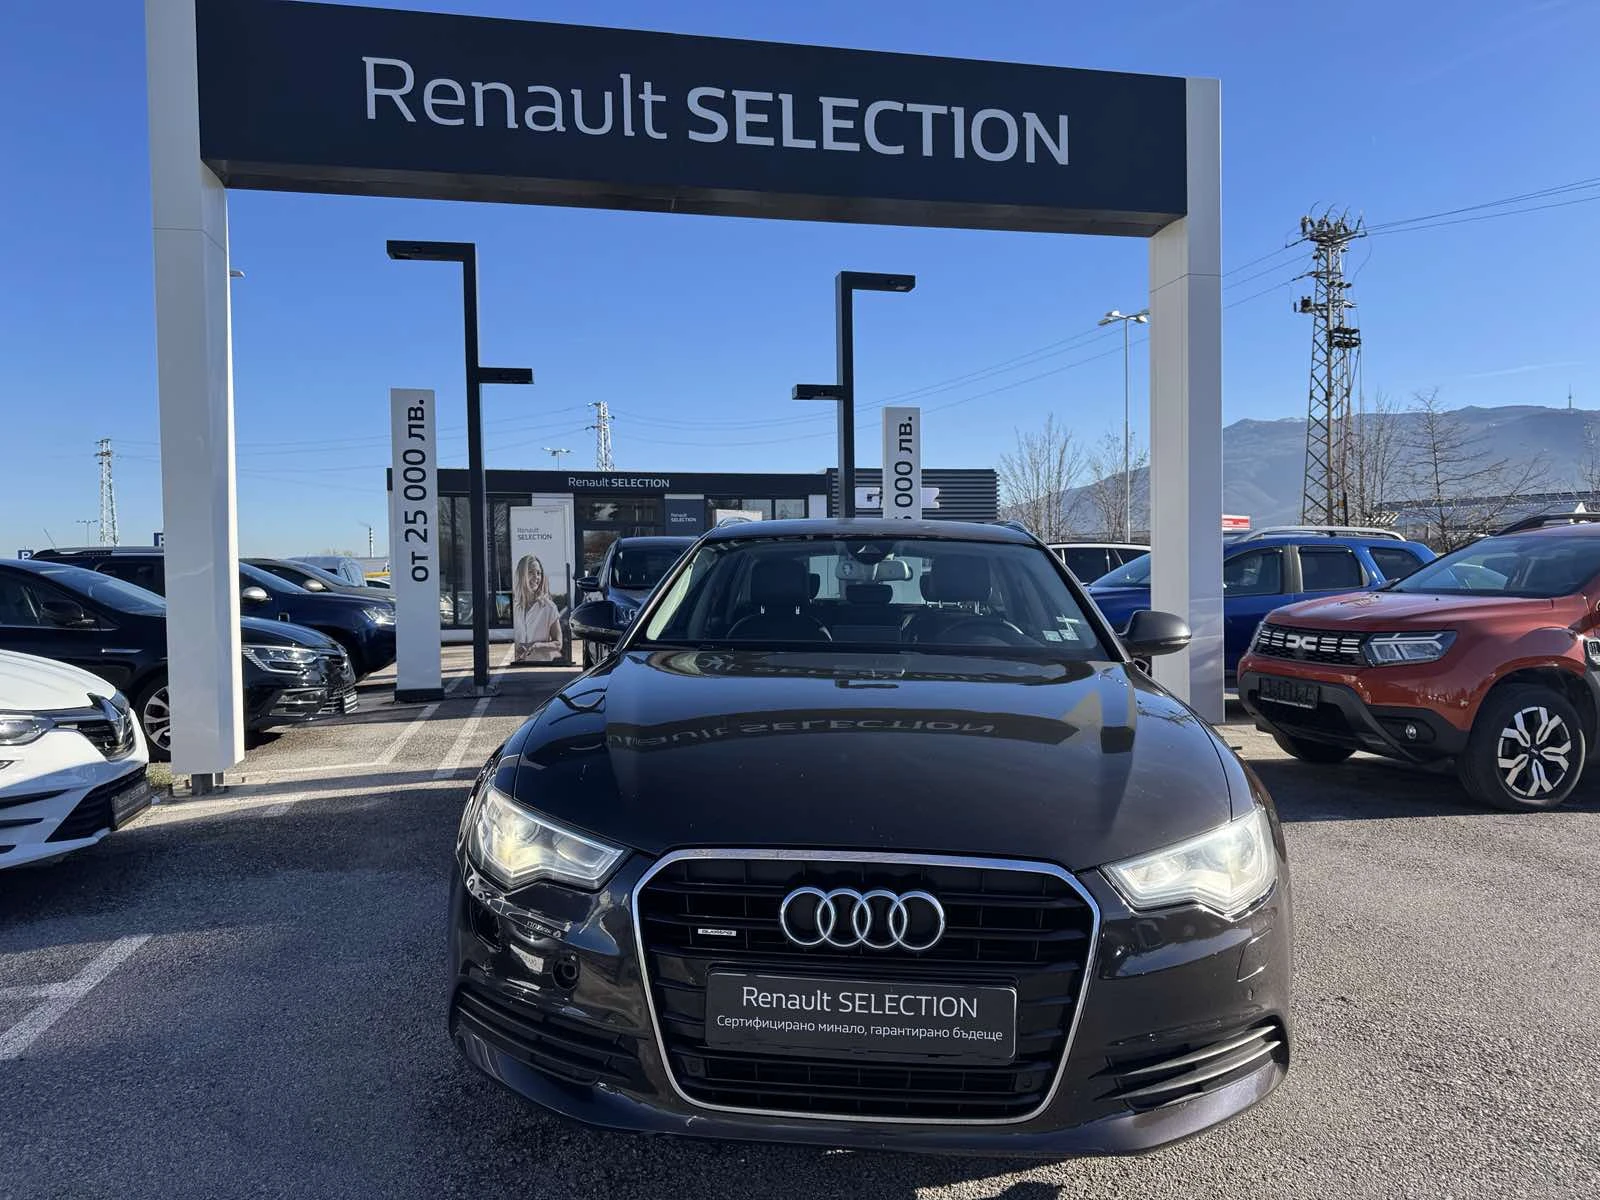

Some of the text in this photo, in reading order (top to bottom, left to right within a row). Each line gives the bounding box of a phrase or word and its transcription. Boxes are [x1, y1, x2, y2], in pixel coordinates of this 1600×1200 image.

[361, 56, 1069, 166] Renault SELECTION
[898, 416, 913, 454] лв.
[402, 399, 429, 582] от 25 000 лв.
[568, 477, 670, 488] Renault SELECTION
[517, 533, 553, 541] SELECTION
[742, 986, 978, 1018] Renault SELECTION
[717, 1015, 1003, 1042] Сертифицирано минало, гарантирано бъдеще
